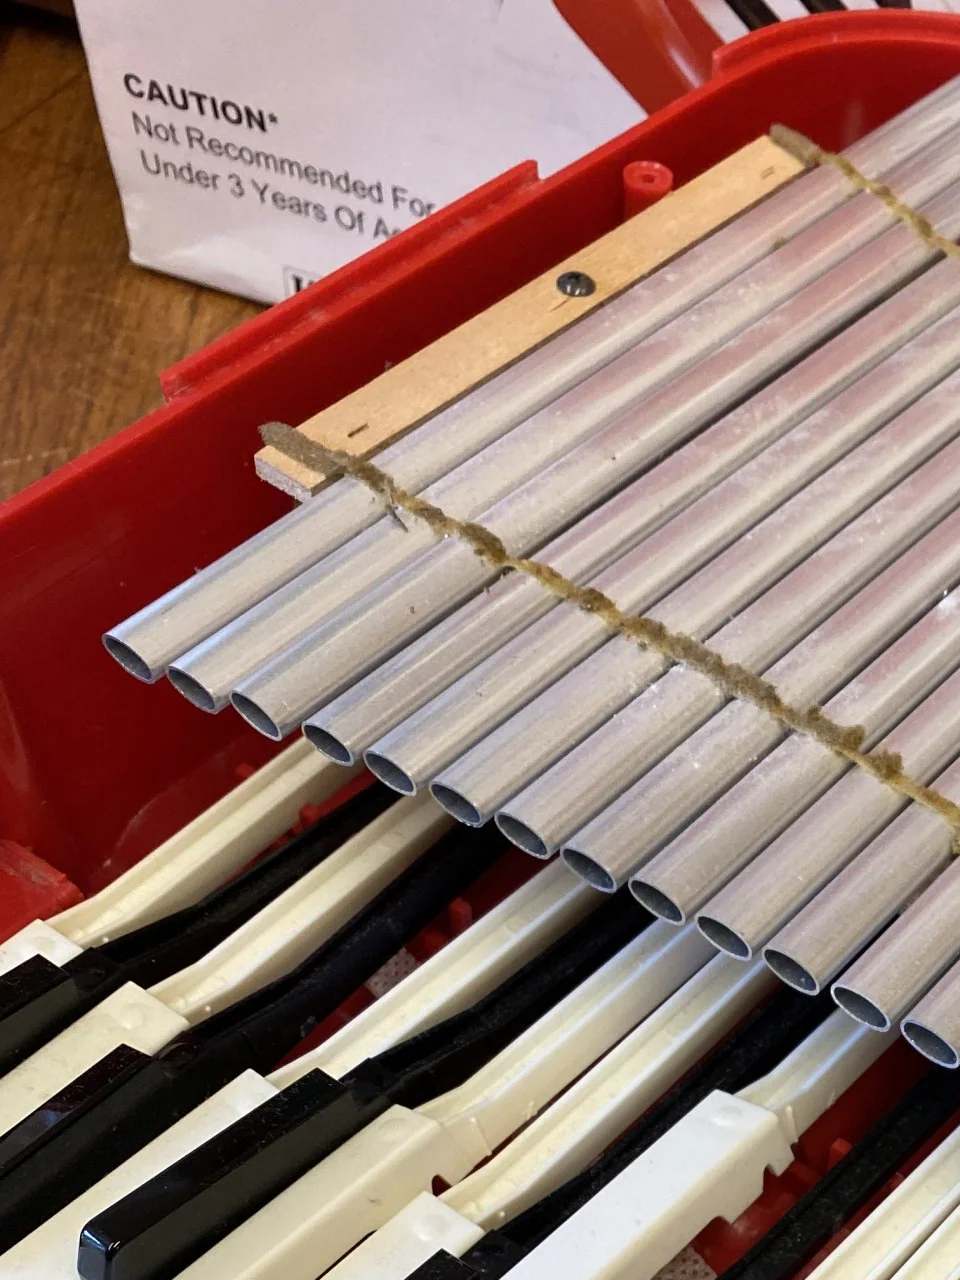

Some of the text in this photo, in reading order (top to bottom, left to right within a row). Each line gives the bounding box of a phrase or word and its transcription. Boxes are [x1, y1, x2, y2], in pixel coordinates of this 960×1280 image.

[131, 111, 437, 217] Not Recommended For
[140, 149, 221, 190] Under
[227, 172, 245, 198] 3
[250, 178, 328, 223] Years
[333, 205, 365, 234] Of
